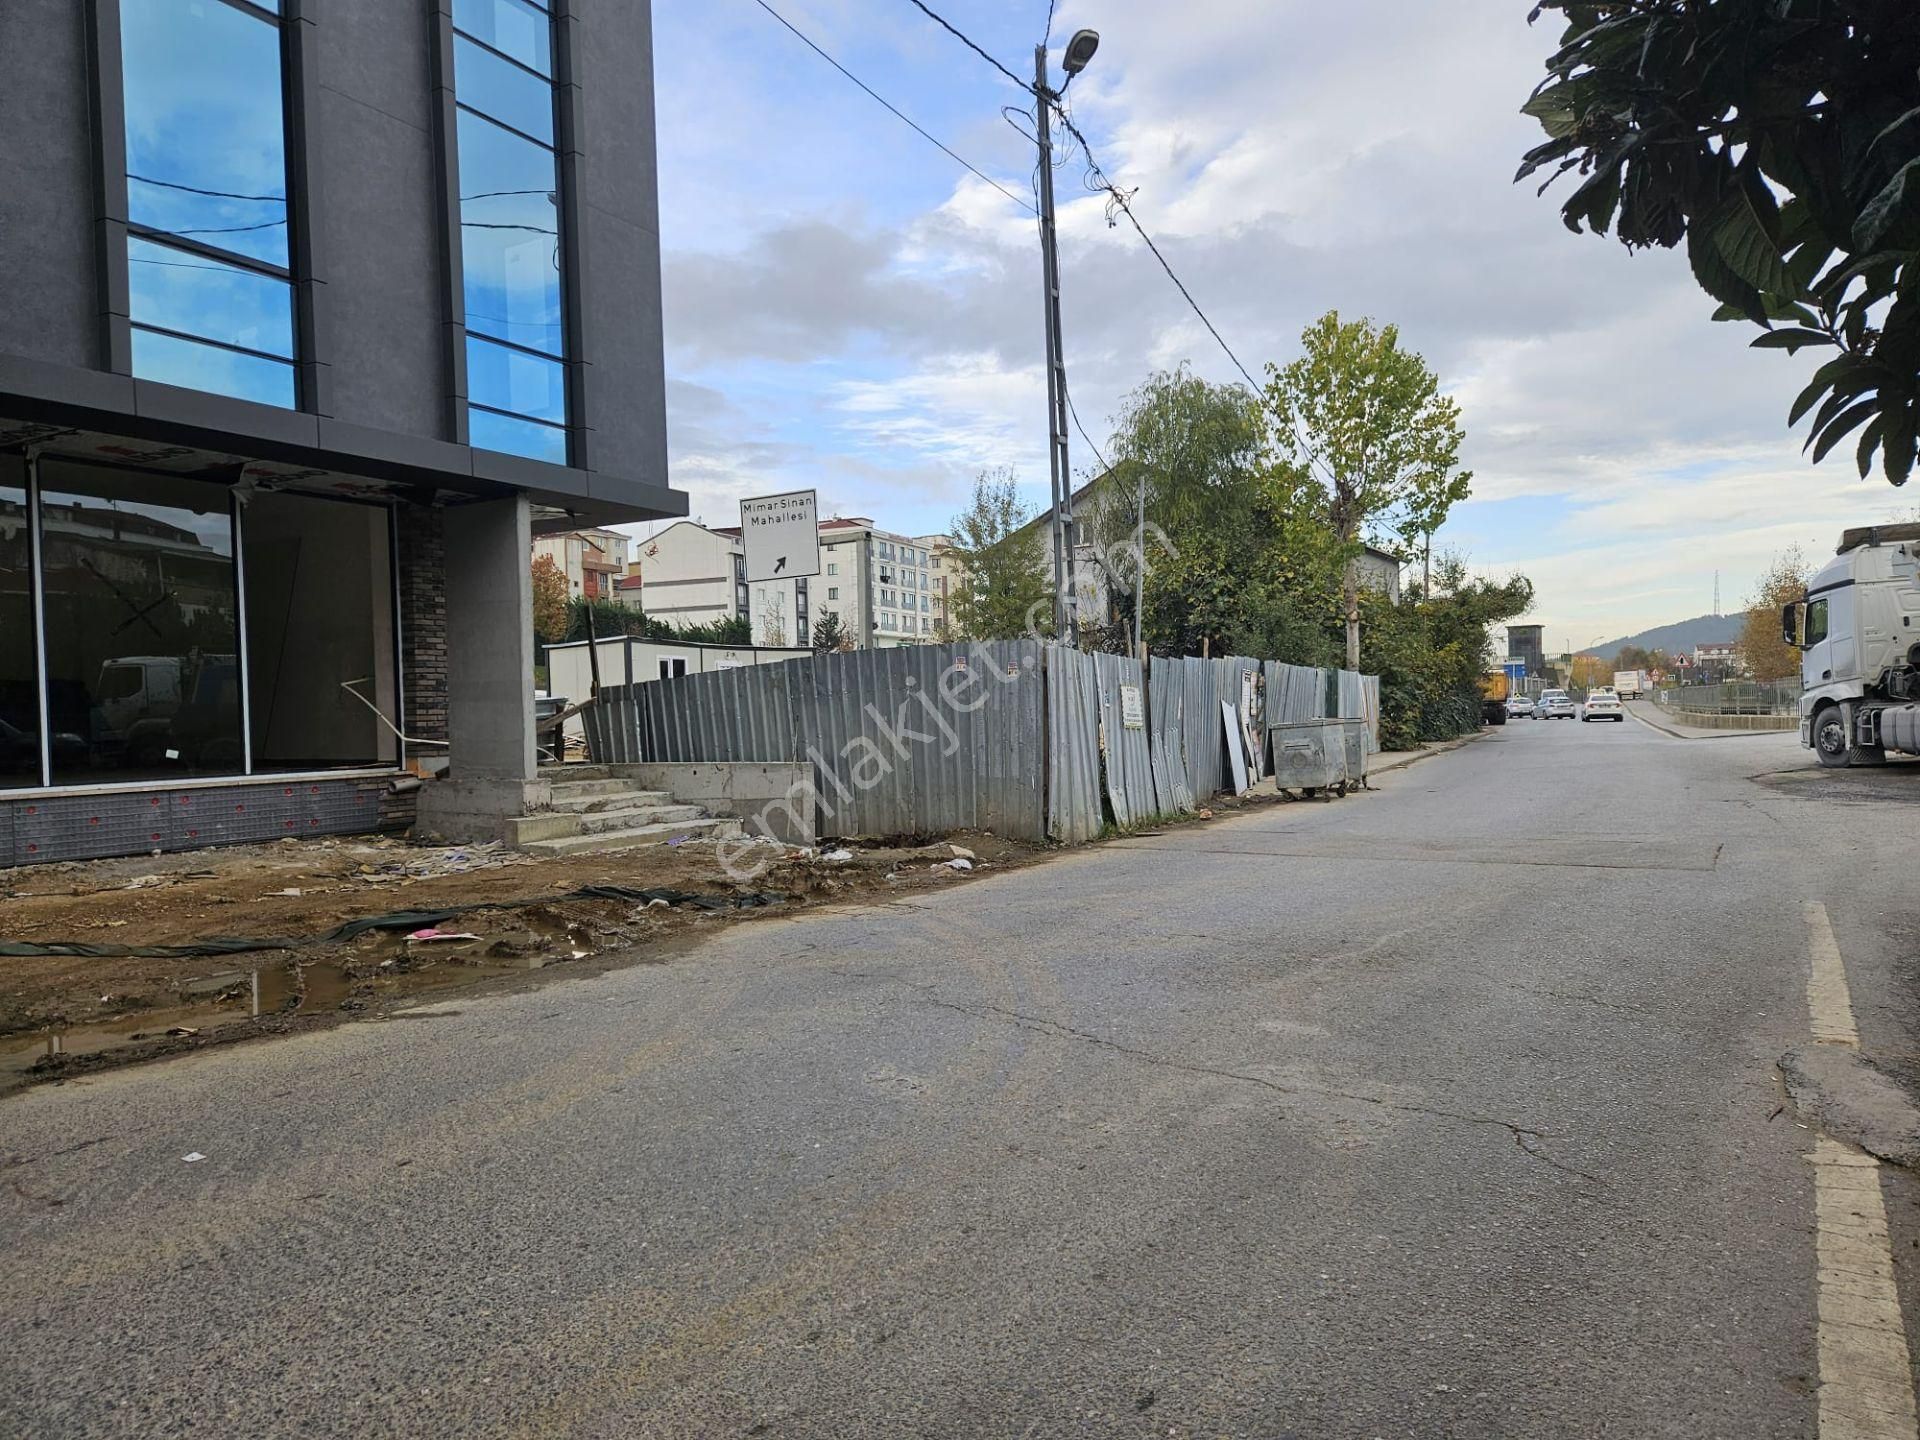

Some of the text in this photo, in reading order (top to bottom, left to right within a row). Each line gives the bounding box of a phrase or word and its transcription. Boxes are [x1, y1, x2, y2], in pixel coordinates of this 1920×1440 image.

[743, 497, 812, 514] Mimar Sinan
[751, 511, 807, 526] Mahallesi
